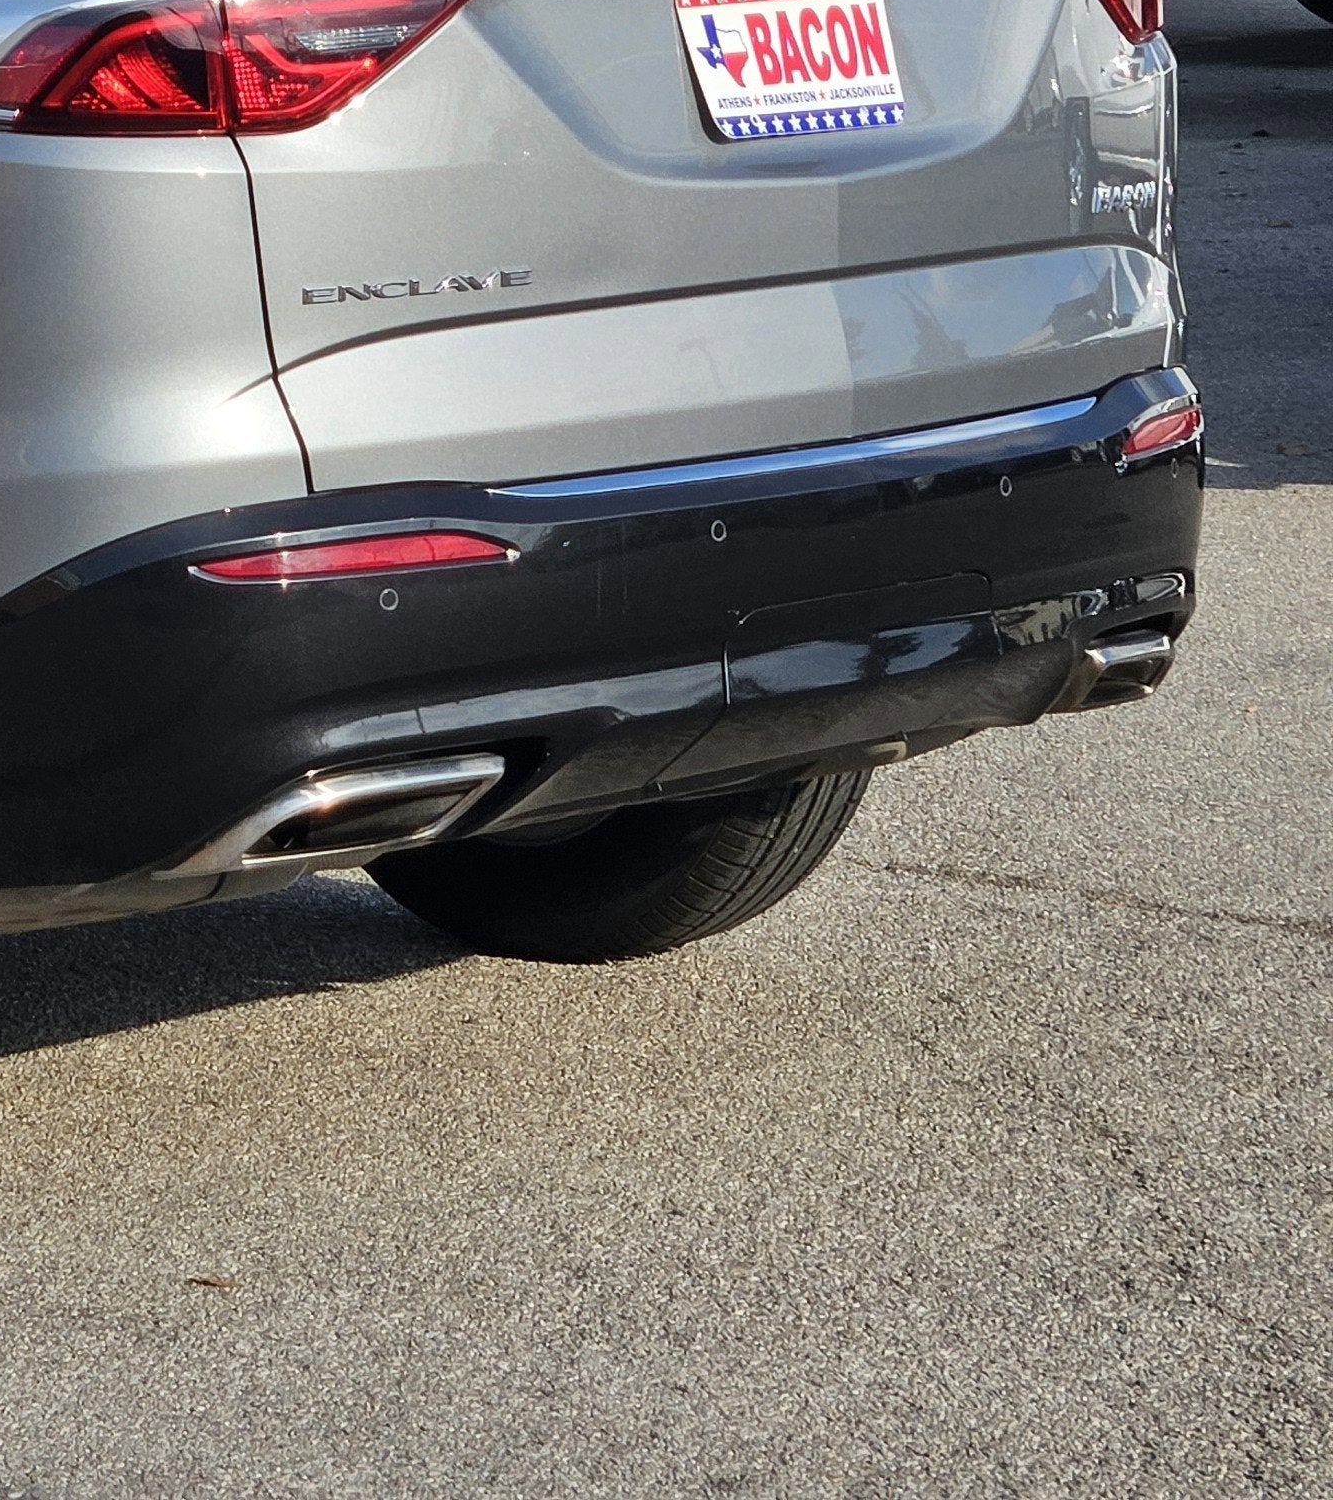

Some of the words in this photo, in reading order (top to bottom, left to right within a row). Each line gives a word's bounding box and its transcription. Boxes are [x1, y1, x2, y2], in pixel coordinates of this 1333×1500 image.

[744, 3, 890, 86] BACON
[718, 97, 753, 110] ATHENS
[763, 91, 817, 106] FRANKSTON
[829, 84, 896, 100] JACKSONVILLE
[301, 269, 534, 305] ENCLAVE
